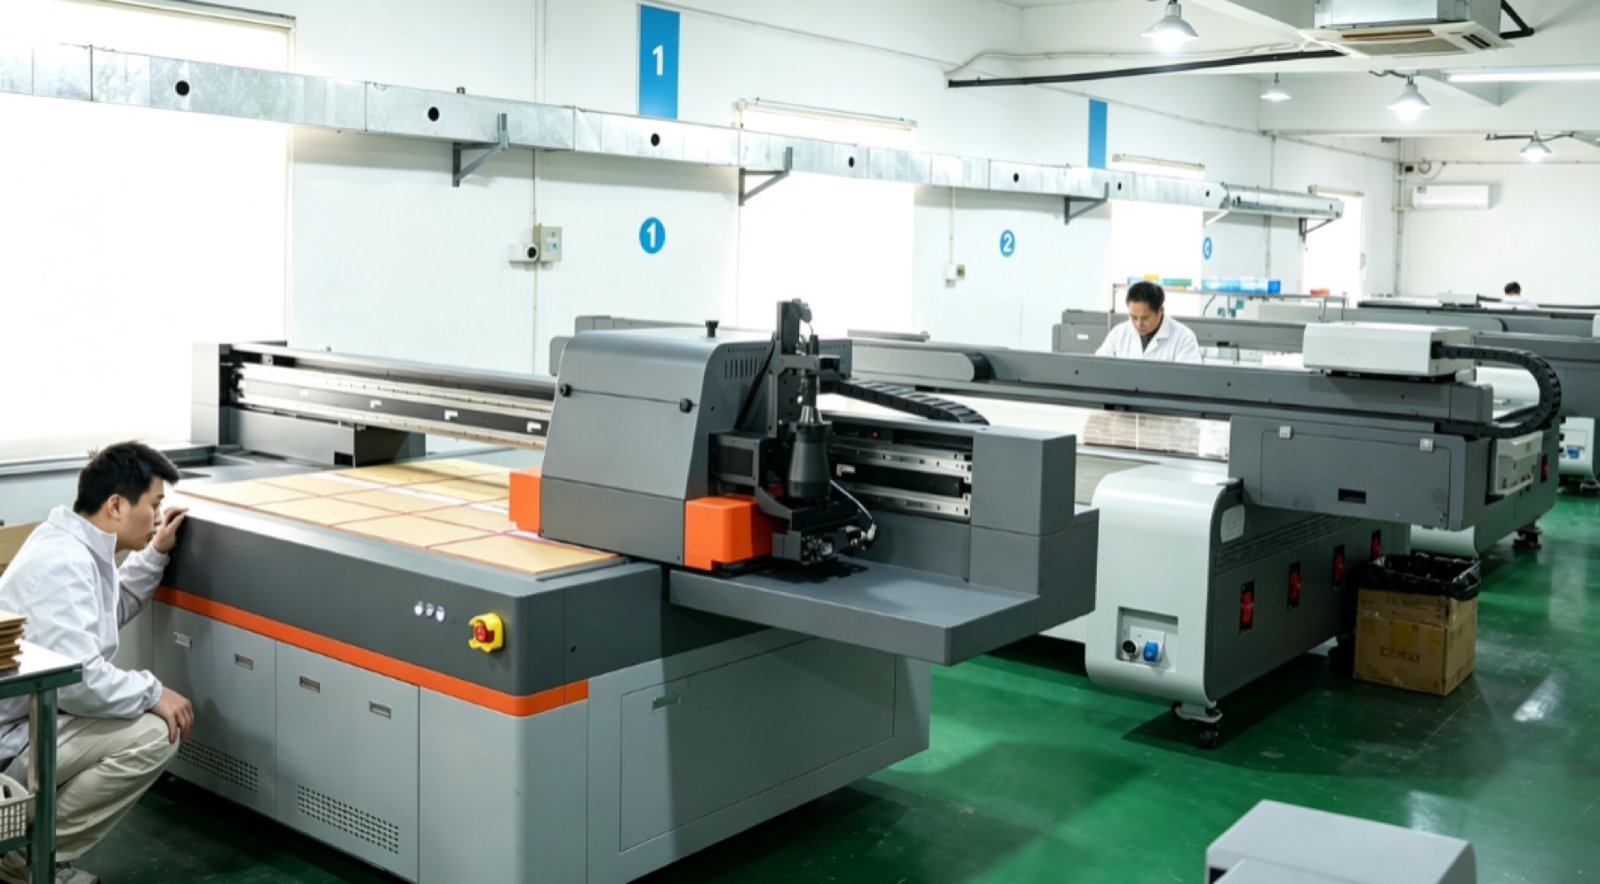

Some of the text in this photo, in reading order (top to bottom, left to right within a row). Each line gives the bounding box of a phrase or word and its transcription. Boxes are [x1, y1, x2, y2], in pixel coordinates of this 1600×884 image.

[652, 44, 664, 76] 1
[646, 222, 657, 248] 1
[1003, 233, 1014, 252] 2
